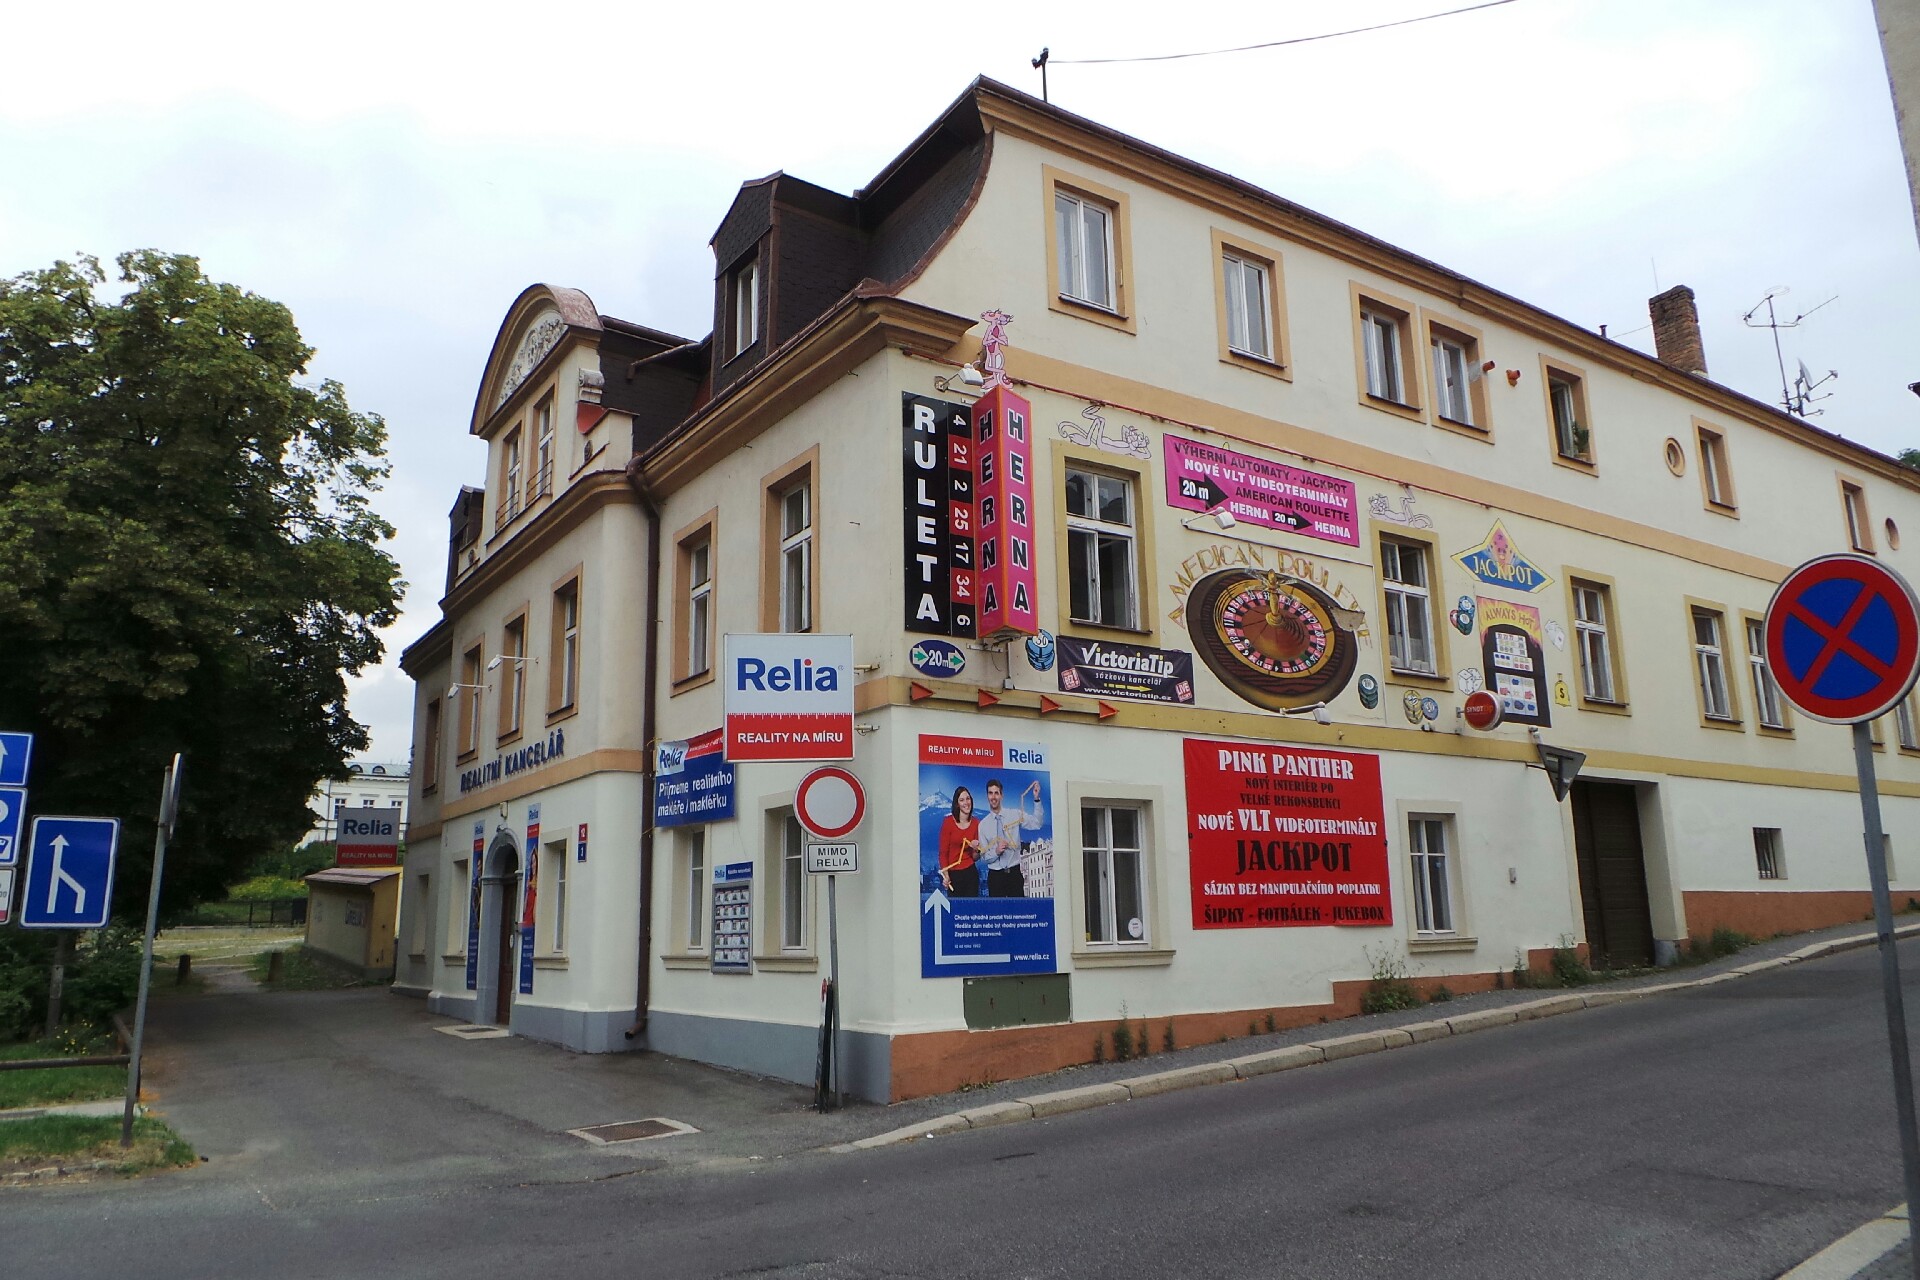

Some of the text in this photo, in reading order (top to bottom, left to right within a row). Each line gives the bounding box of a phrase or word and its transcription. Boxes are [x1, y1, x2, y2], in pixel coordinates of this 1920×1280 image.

[953, 442, 968, 465] 21
[1174, 441, 1227, 465] VÝHERNÍ
[1230, 456, 1290, 481] AUTOMATY
[1300, 474, 1348, 494] JACKPOT
[954, 479, 968, 492] 2
[1182, 479, 1210, 500] 20 m
[1184, 458, 1348, 509] NOVÉ VLT VIDEOTERMINÁLY
[913, 403, 940, 622] RULETA
[980, 408, 999, 616] HERNA
[1007, 407, 1031, 615] HERNA
[1235, 486, 1350, 522] AMERICAN ROULETTE
[954, 506, 969, 531] 25
[1230, 501, 1270, 521] HERNA
[1274, 512, 1286, 524] 20
[1314, 520, 1351, 539] HERNA
[955, 541, 969, 564] 17
[1473, 555, 1533, 585] JACKPOT
[956, 574, 971, 598] 34
[1168, 543, 1264, 629] AMERICAN
[1485, 607, 1517, 622] ALWAYS
[1081, 643, 1174, 678] VictoriaTip
[737, 657, 838, 692] Relia
[1095, 672, 1162, 686] sázková kancelář
[1084, 686, 1172, 701] www.victoriatip.cz
[737, 730, 843, 743] REALITY NA MÍRU
[460, 728, 565, 793] REALITNÍ KANCELÁŘ
[660, 747, 684, 769] Relia
[928, 745, 995, 757] REALITY NA MÍRU
[1009, 748, 1043, 765] Relia
[1218, 749, 1354, 780] PINK PANTHER
[692, 771, 733, 791] realitního
[1245, 775, 1334, 793] NOVÝ INTERIÉR PO
[657, 799, 685, 817] makléře
[689, 793, 727, 813] makléřku
[1240, 791, 1341, 810] VELKÉ REKONSRUKCI
[343, 819, 393, 836] Relia
[1198, 808, 1377, 836] NOVÉ VLT VIDEOTERMINÁLY
[816, 858, 850, 867] RELIA
[818, 847, 848, 856] MIMO
[1235, 840, 1352, 876] JACKPOT
[1204, 880, 1381, 896] SÁZKY BEZ MANIPULAČNÍHO POPLATKU
[1204, 904, 1245, 924] ŠIPKY
[1257, 903, 1321, 922] FOTBÁLEK
[1332, 906, 1385, 924] JUKEBOX
[1014, 953, 1050, 961] www.relia.cz
